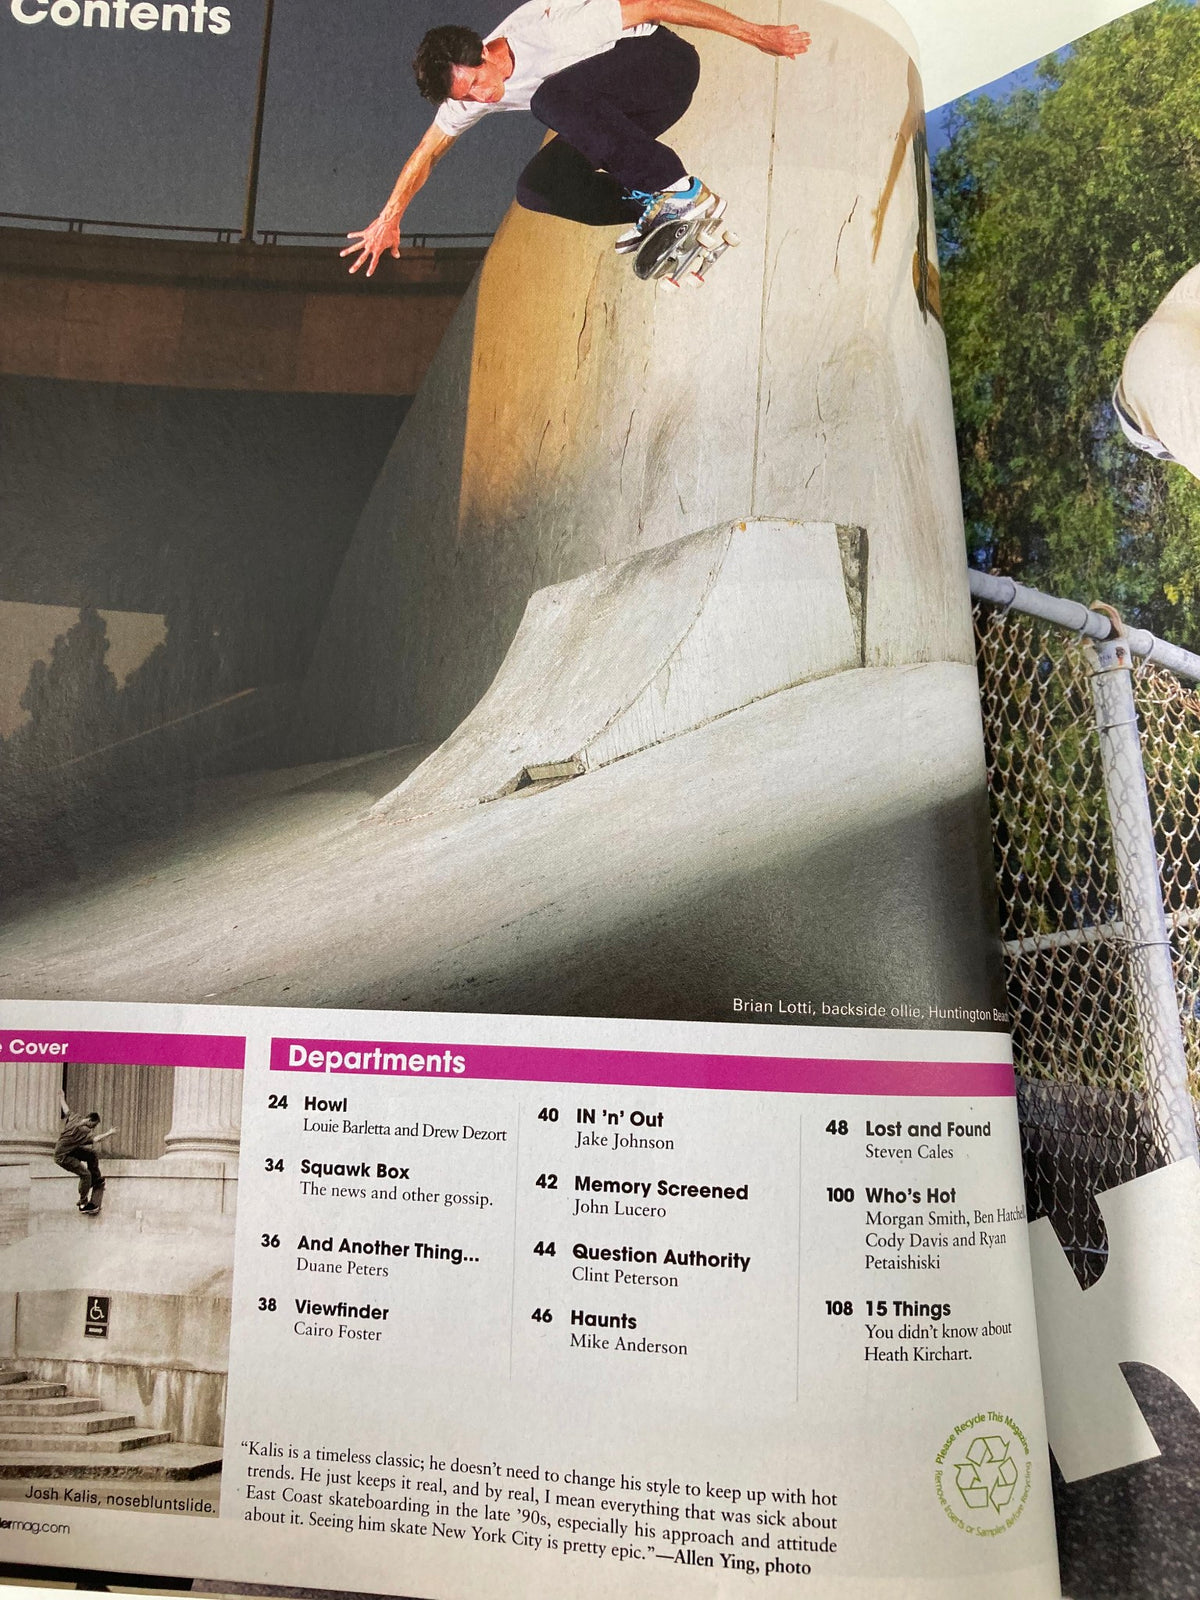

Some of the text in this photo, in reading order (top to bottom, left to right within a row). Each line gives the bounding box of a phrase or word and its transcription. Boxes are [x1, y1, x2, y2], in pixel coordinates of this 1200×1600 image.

[10, 0, 231, 35] Contents
[733, 997, 773, 1013] Brian
[778, 999, 816, 1016] Lotti,
[822, 1001, 886, 1017] backside
[890, 1004, 925, 1020] ollie,
[928, 1005, 992, 1023] Huntington
[9, 1038, 69, 1055] Cover
[288, 1045, 466, 1074] Departments
[267, 1094, 348, 1113] 24 Howl
[537, 1107, 664, 1128] 40 IN ’n’ Out
[825, 1119, 992, 1138] 48 Lost and Found
[303, 1117, 508, 1142] Louie Barletta and Drew Dezort
[574, 1130, 674, 1151] Jake Johnson
[865, 1143, 954, 1159] Steven Cales
[264, 1157, 410, 1180] 34 Squawk Box
[299, 1180, 493, 1210] The news and other gossip.
[535, 1173, 749, 1201] 42 Memory Screened
[826, 1187, 957, 1204] 100 Who’s Hot
[572, 1198, 667, 1218] John Lucero
[865, 1210, 924, 1230] Morgan
[928, 1209, 971, 1228] Smith,
[973, 1209, 995, 1224] Ben
[260, 1233, 281, 1249] 36
[296, 1235, 334, 1252] And
[338, 1237, 410, 1257] Another
[865, 1230, 1007, 1252] Cody Davis and Ryan
[296, 1256, 389, 1278] Duane Peters
[533, 1240, 751, 1273] 44 Question Authority
[865, 1254, 941, 1270] Petaishiski
[572, 1266, 678, 1287] Clint Peterson
[257, 1296, 390, 1321] 38 Viewfinder
[531, 1307, 637, 1330] 46 Haunts
[825, 1300, 952, 1322] 108 15 Things
[293, 1321, 383, 1341] Cairo Foster
[864, 1320, 1012, 1340] You didn’t know about
[569, 1332, 688, 1356] Mike Anderson
[864, 1345, 972, 1362] Heath Kirchart.
[935, 1411, 1030, 1465] Please Recycle This Magazine
[241, 1440, 838, 1507] “Kalis is a timeless classic; he doesn’t need to change his style to keep up with hot
[24, 1485, 216, 1514] Josh Kalis, nosebluntslide.
[247, 1464, 838, 1530] trends. He just keeps it real, and by real, I mean everything that was sick about
[934, 1469, 947, 1506] Remove
[944, 1504, 965, 1530] Inserts
[975, 1525, 1007, 1538] Samples
[0, 1517, 71, 1535] ermag.com
[246, 1484, 838, 1553] East Coast skateboarding in the late ’90s, especially his approach and attitude
[244, 1506, 286, 1524] about
[290, 1509, 305, 1526] it.
[308, 1511, 354, 1533] Seeing
[358, 1515, 386, 1532] him
[390, 1518, 428, 1536] skate
[431, 1522, 466, 1540] New
[471, 1525, 507, 1544] York
[511, 1530, 543, 1551] City
[547, 1533, 560, 1551] is
[563, 1540, 607, 1559] pretty
[719, 1552, 760, 1575] Ying,
[765, 1556, 812, 1577] photo
